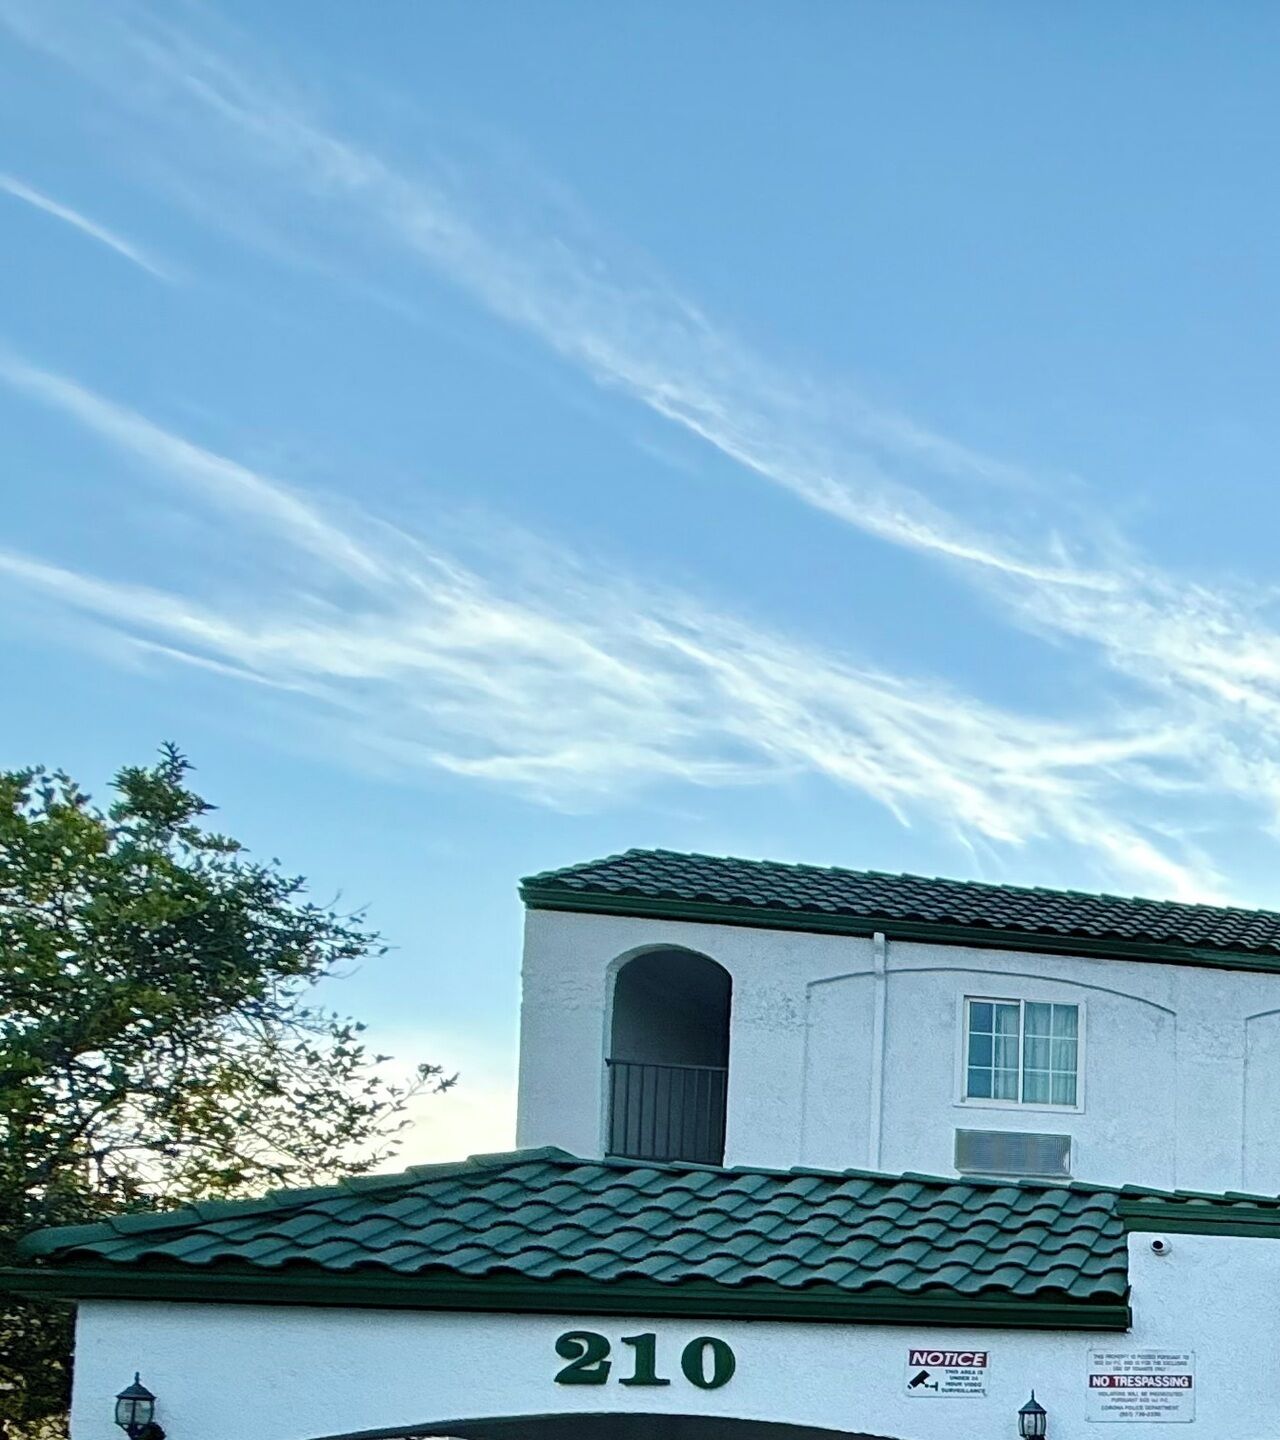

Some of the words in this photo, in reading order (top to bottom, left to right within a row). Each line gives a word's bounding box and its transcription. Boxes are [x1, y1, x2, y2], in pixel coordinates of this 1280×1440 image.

[553, 1330, 737, 1391] 210
[911, 1351, 985, 1367] NOTICE
[1092, 1376, 1110, 1387] NO
[1113, 1376, 1189, 1387] TRESPASSING
